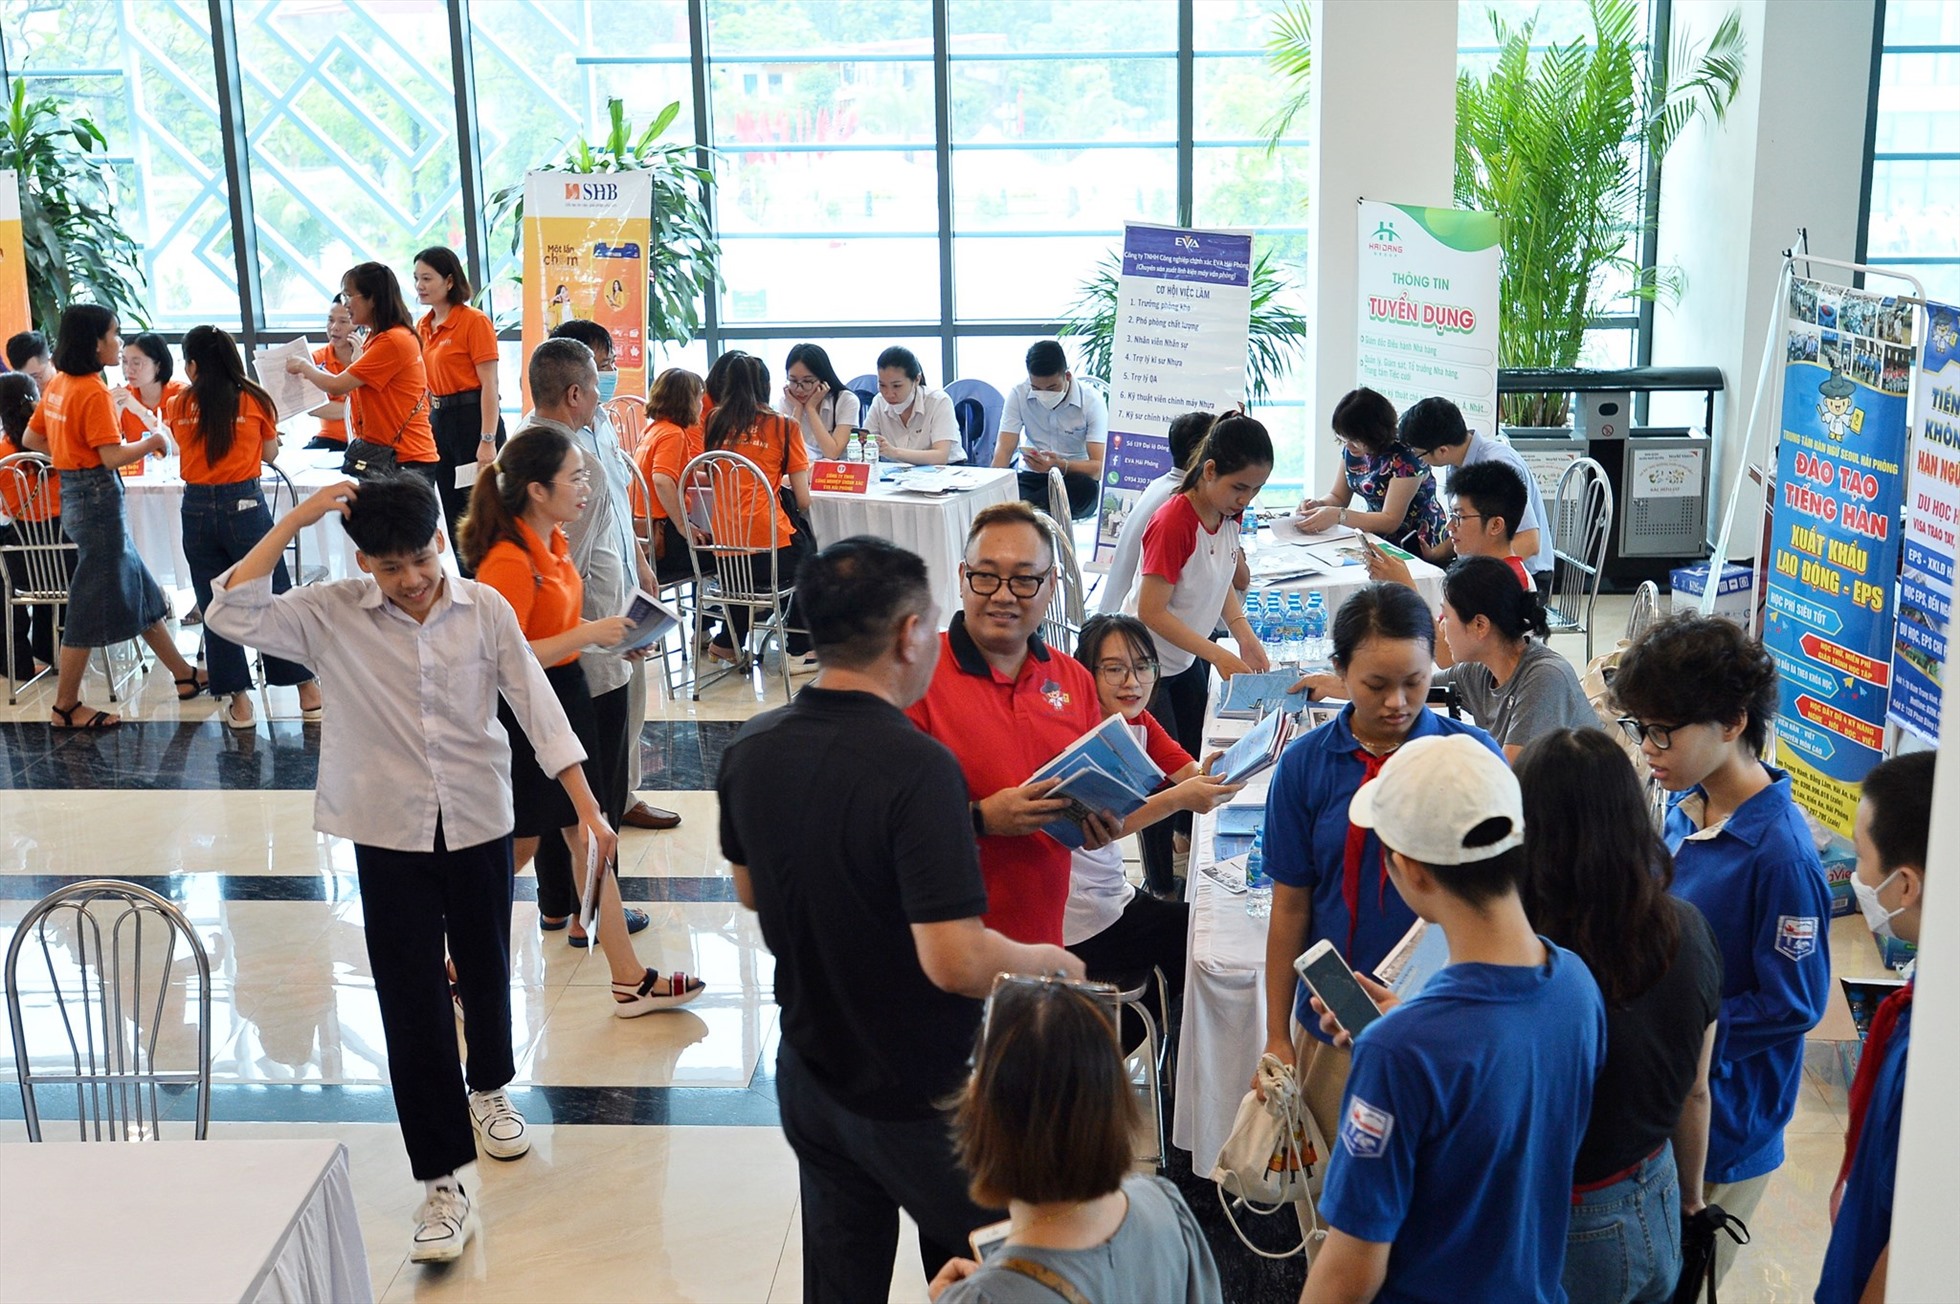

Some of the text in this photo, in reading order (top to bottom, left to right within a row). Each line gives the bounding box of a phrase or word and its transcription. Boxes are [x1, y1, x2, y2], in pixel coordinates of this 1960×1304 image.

[583, 183, 618, 201] SHB
[1175, 236, 1200, 249] EVA
[1392, 271, 1449, 290] THÔNG TIN
[1156, 284, 1211, 299] CƠ HỘI VIỆC LÀM
[1369, 291, 1475, 331] TUYỂN DỤNG
[1128, 315, 1135, 324] 2.
[1135, 316, 1148, 325] Phó
[1149, 317, 1167, 328] phòng
[1127, 334, 1133, 343] 3.
[1125, 353, 1131, 362] 4.
[1123, 371, 1130, 380] 5.
[1131, 372, 1143, 383] Trợ
[1150, 374, 1158, 383] QA
[1120, 390, 1127, 399] 6.
[1118, 410, 1125, 418] 7.
[1840, 448, 1860, 465] SEOUL
[1872, 458, 1898, 475] PHÒNG
[1917, 449, 1938, 478] HÀN
[1795, 451, 1879, 502] ĐÀO TẠO
[1785, 481, 1888, 542] TIẾNG HÀN
[1917, 493, 1931, 513] DU
[1932, 499, 1952, 522] HỌC
[1913, 517, 1927, 535] VISA
[1928, 523, 1943, 541] TRAO
[1790, 524, 1868, 575] XUẤT KHẨU
[1908, 547, 1923, 565] EPS
[1776, 549, 1885, 613] LAO ĐỘNG - EPS
[1770, 591, 1784, 608] HỌC
[1812, 609, 1827, 626] TỐT
[1928, 594, 1940, 613] ĐẾN
[1921, 632, 1934, 651] EPS
[1821, 678, 1834, 691] HỌC
